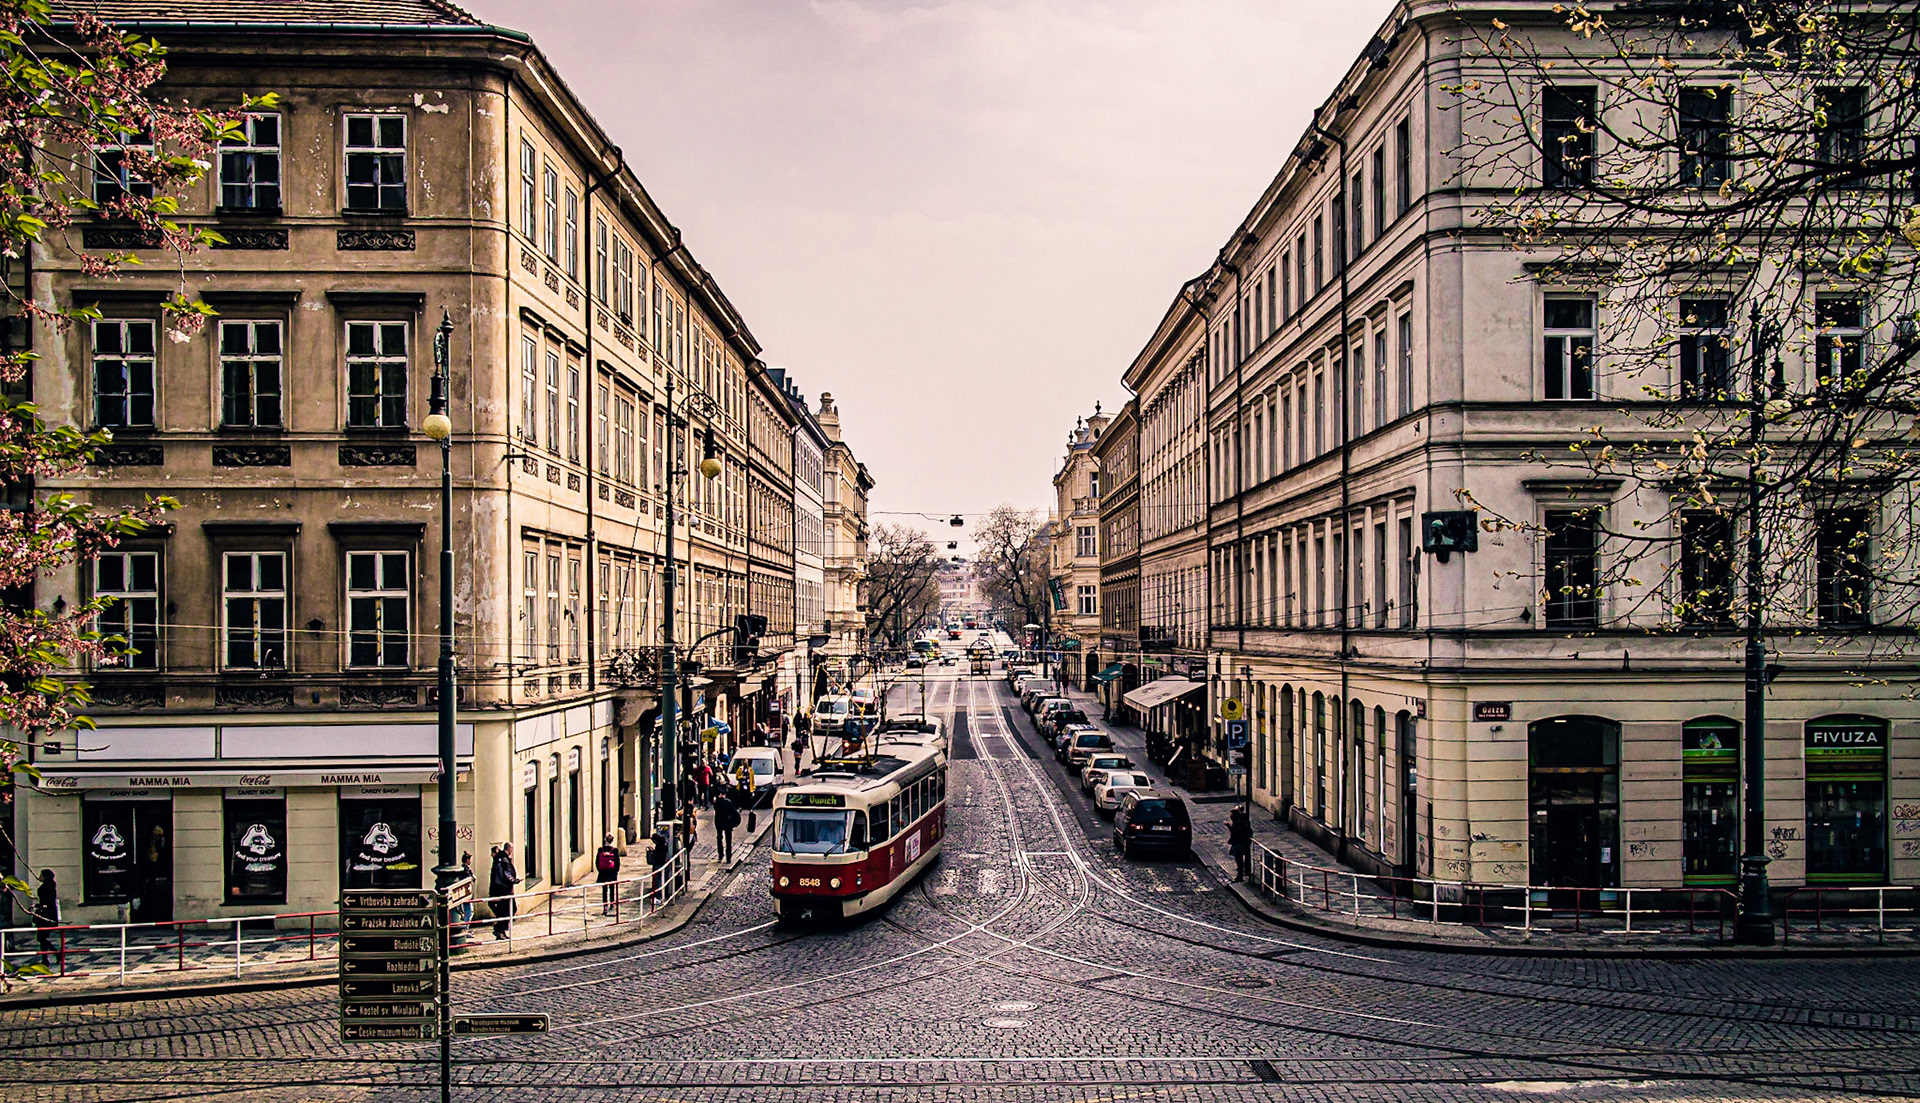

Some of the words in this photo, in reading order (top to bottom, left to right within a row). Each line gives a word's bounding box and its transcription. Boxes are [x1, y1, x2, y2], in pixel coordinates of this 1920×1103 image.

[1232, 724, 1243, 740] P
[1814, 732, 1878, 743] FIVUZA
[129, 778, 169, 787] MAMMA
[172, 777, 191, 786] MIA
[321, 775, 360, 784] MAMMA
[363, 774, 382, 783] MIA
[788, 794, 803, 804] 22
[799, 878, 821, 887] 8548
[393, 896, 418, 906] zahrada
[386, 961, 418, 972] Rozhledna
[392, 983, 419, 994] Lanovka
[360, 1005, 379, 1015] Kostel
[401, 1026, 419, 1038] hudby
